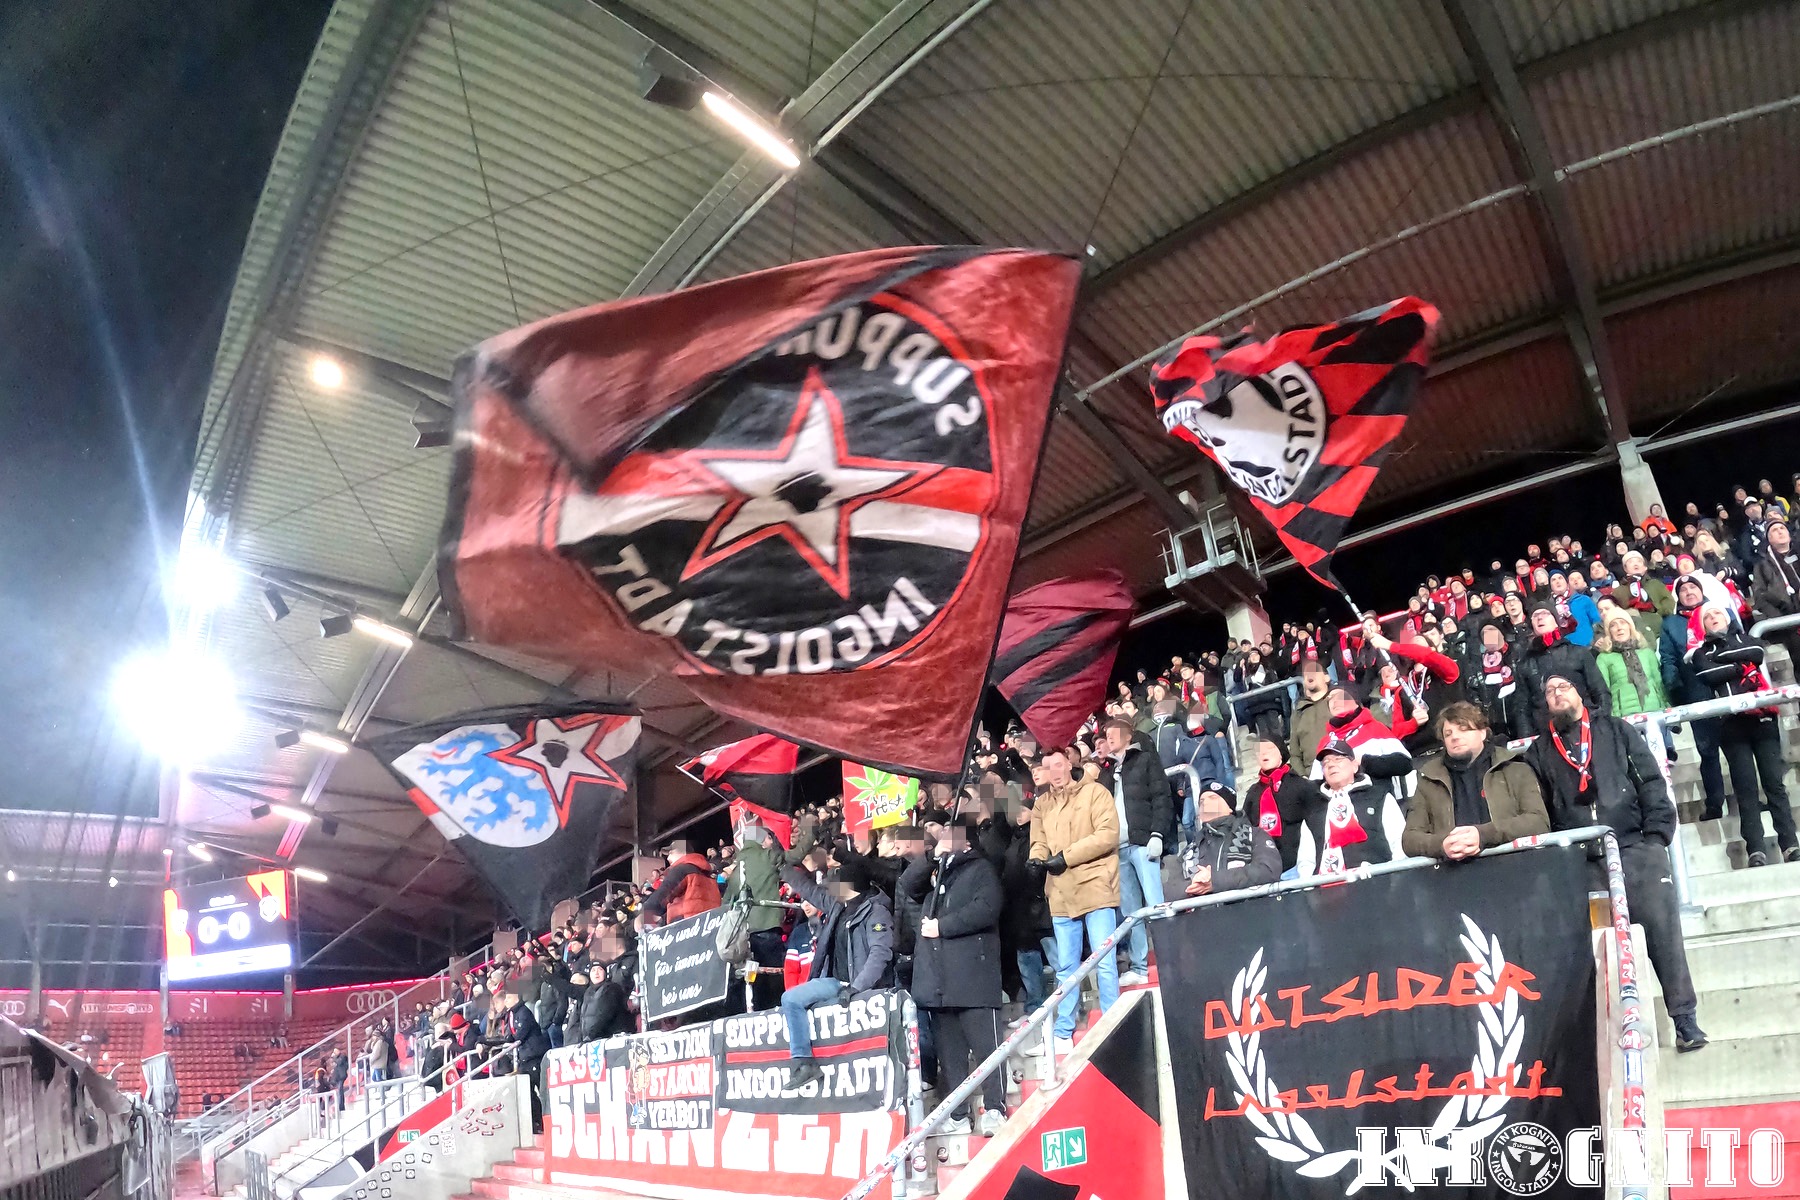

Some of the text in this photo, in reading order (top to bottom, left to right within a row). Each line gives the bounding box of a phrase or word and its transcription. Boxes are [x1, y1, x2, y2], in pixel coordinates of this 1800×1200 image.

[675, 917, 701, 943] und
[725, 992, 888, 1048] SUPPTERS
[1203, 961, 1541, 1040] OUTSIDER
